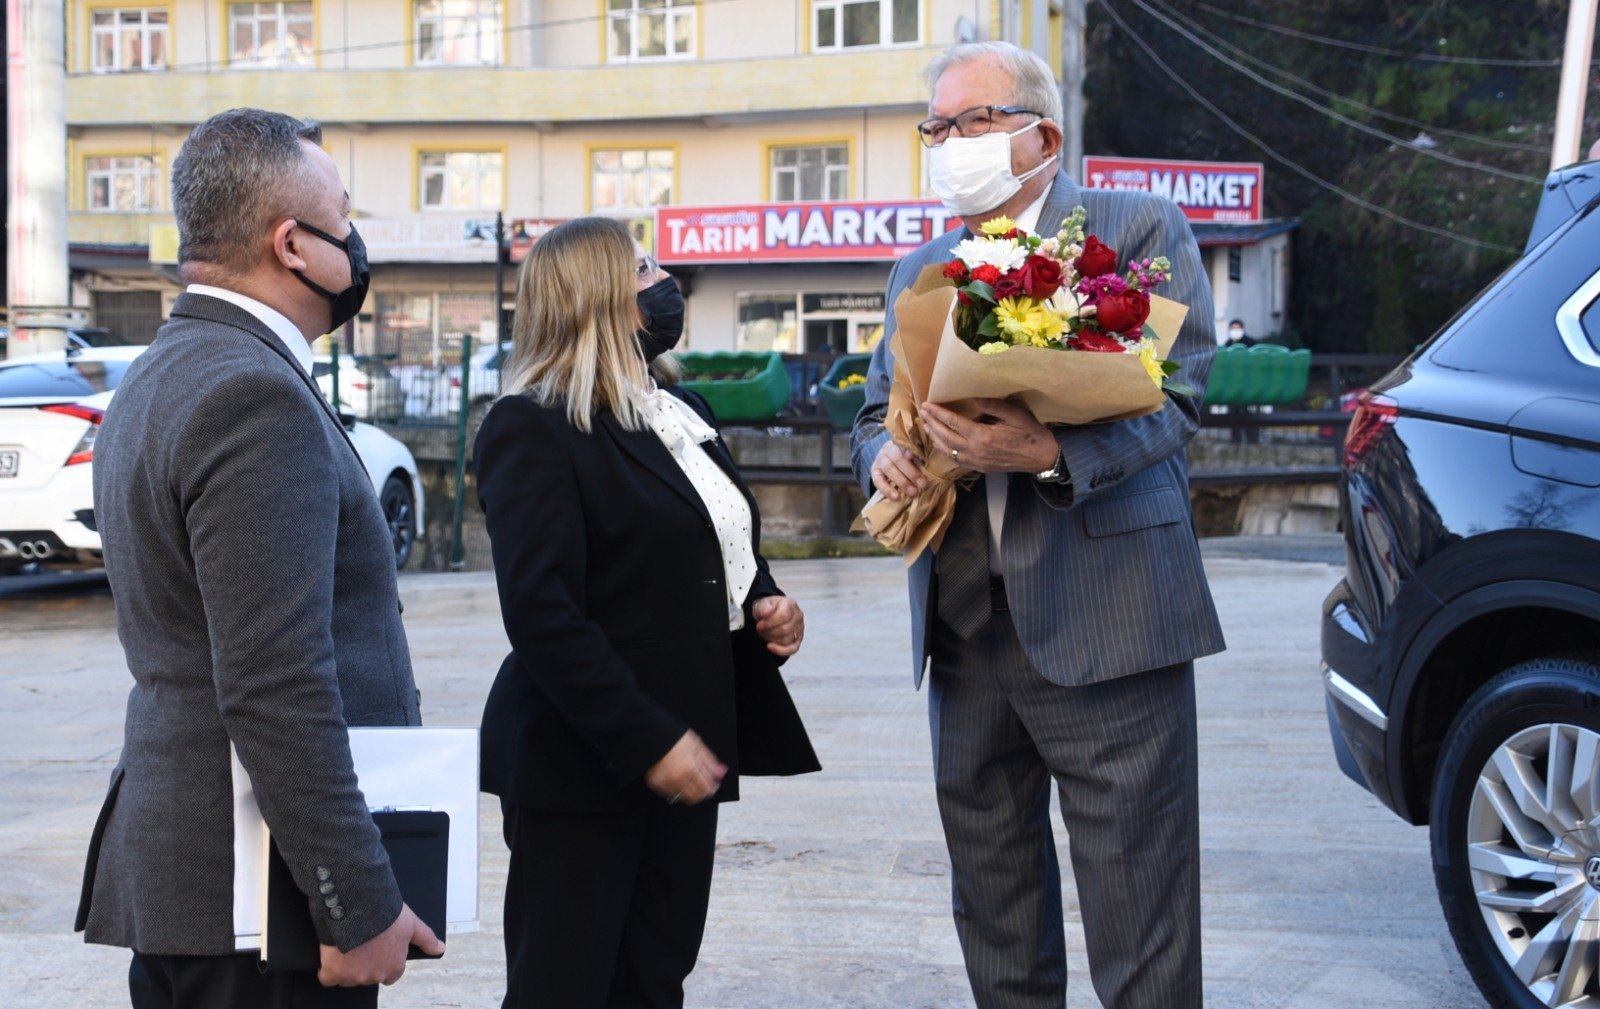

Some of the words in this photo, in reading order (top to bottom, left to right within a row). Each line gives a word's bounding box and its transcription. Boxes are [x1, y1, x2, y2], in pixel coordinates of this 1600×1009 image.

[1151, 171, 1256, 206] MARKET
[667, 217, 759, 253] TARIM
[765, 207, 950, 247] MARKET
